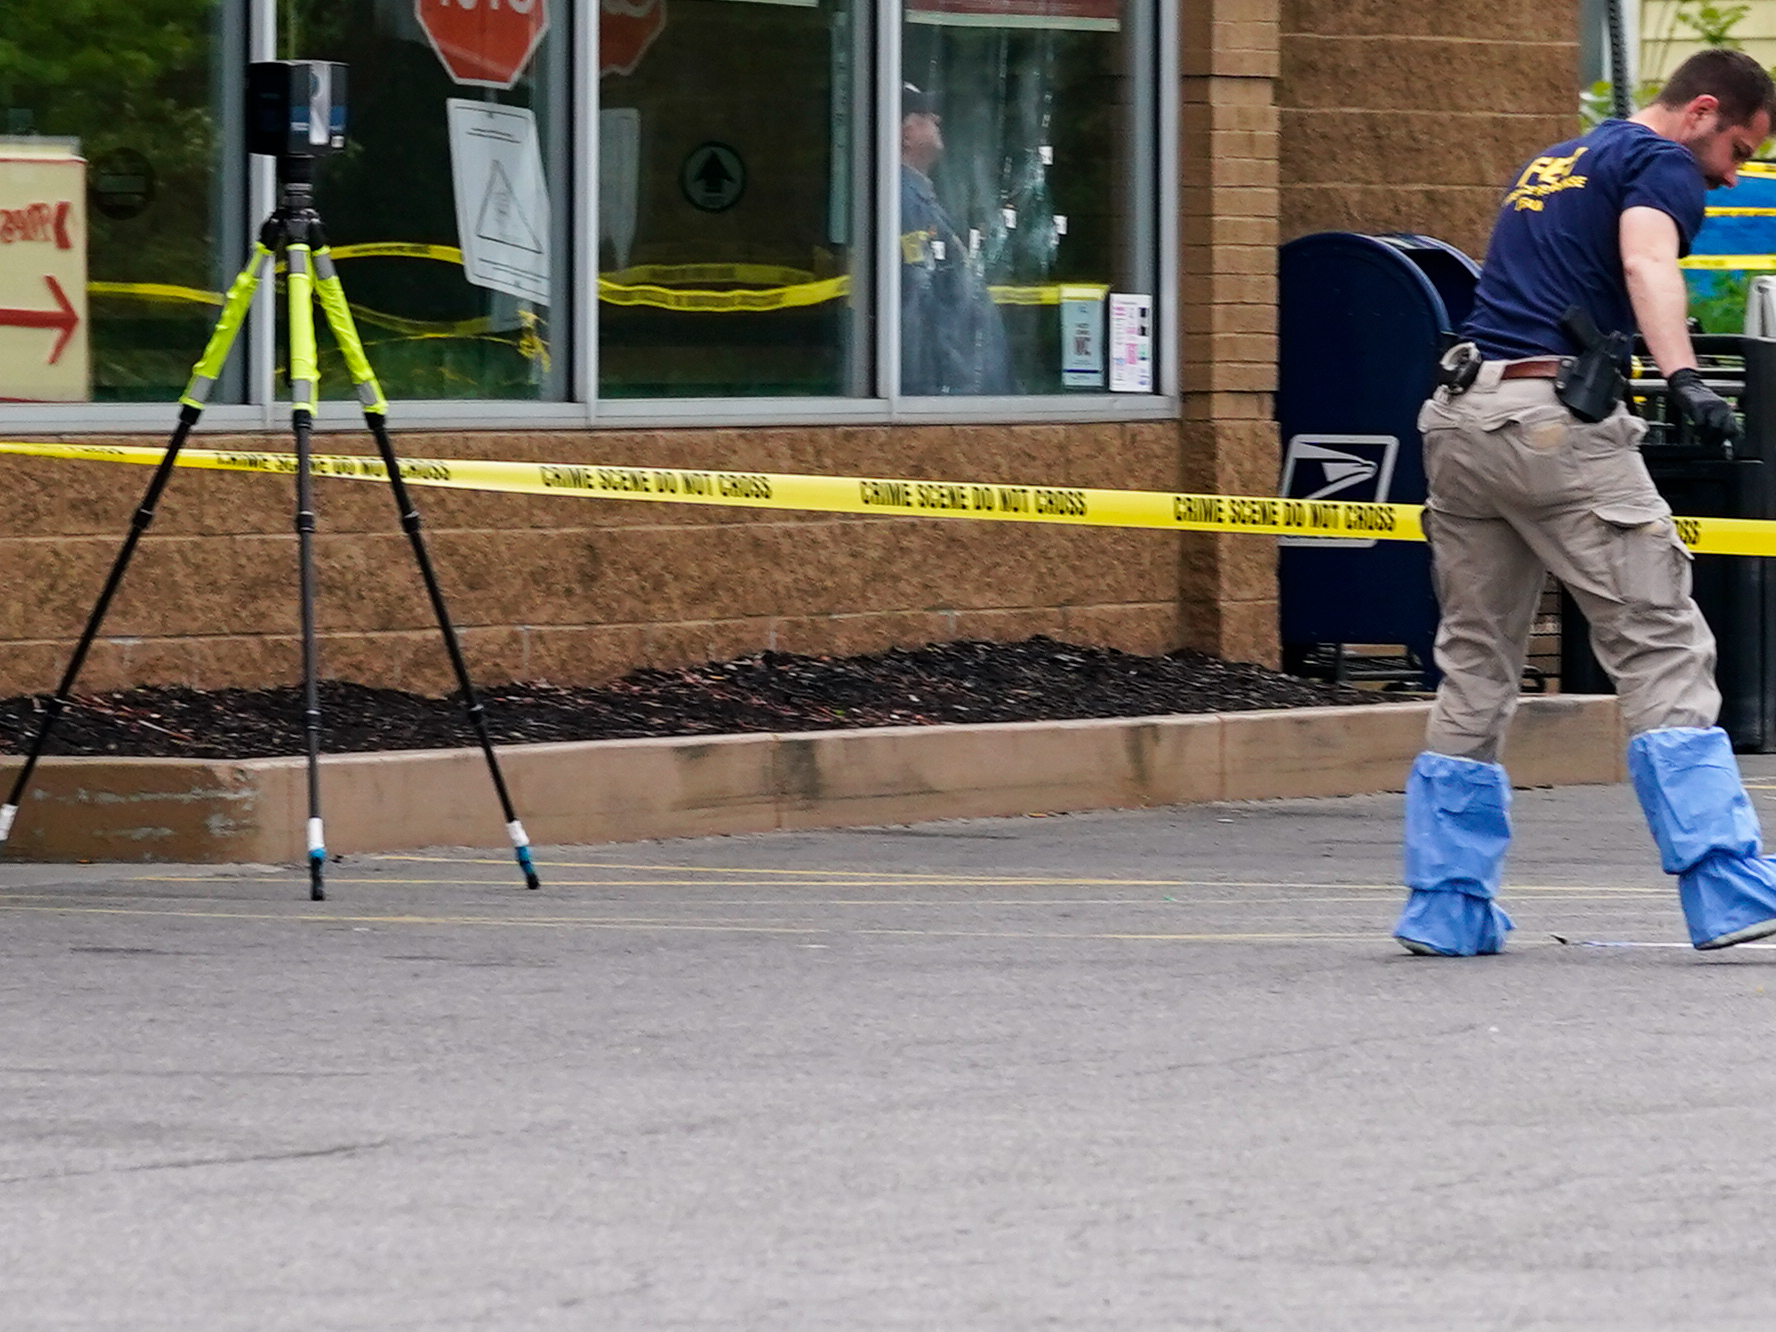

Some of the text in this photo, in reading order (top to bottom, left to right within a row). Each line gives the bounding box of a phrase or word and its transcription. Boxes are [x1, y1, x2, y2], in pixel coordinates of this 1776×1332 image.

[1515, 146, 1589, 188] FBI
[275, 454, 328, 475] SCNE
[332, 456, 356, 476] DO
[394, 460, 452, 482] ROSS
[539, 465, 773, 500] CRIME SCENE DO NOT CROSS
[859, 479, 1088, 517] CRIME SCENE DO NOT CROSS
[1173, 495, 1397, 532] CRIME SCENE DO NOT CROSS
